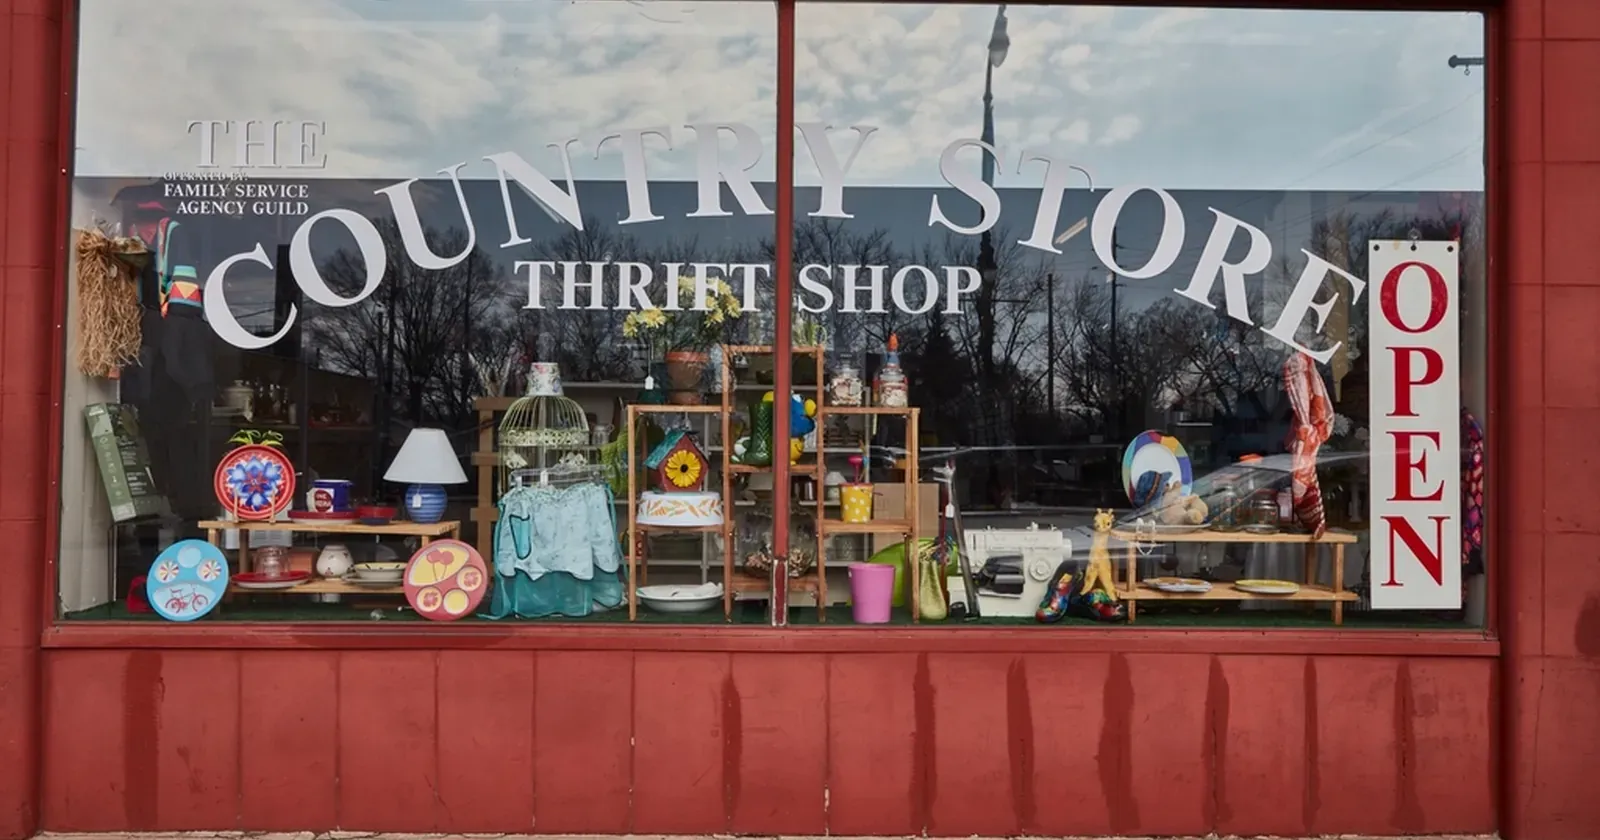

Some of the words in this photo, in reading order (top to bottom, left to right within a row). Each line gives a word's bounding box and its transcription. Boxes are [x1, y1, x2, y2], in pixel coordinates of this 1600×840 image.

[187, 120, 327, 169] THE
[163, 171, 226, 181] OPERATED
[164, 183, 230, 198] FAMILY
[234, 184, 309, 198] SERVICE
[176, 201, 247, 215] AGENCY
[252, 202, 309, 216] GUILD
[204, 122, 878, 350] COUNTRY
[928, 138, 1366, 364] STORE
[513, 261, 770, 312] THRIFT
[797, 263, 982, 314] SHOP
[1379, 261, 1451, 587] OPEN
